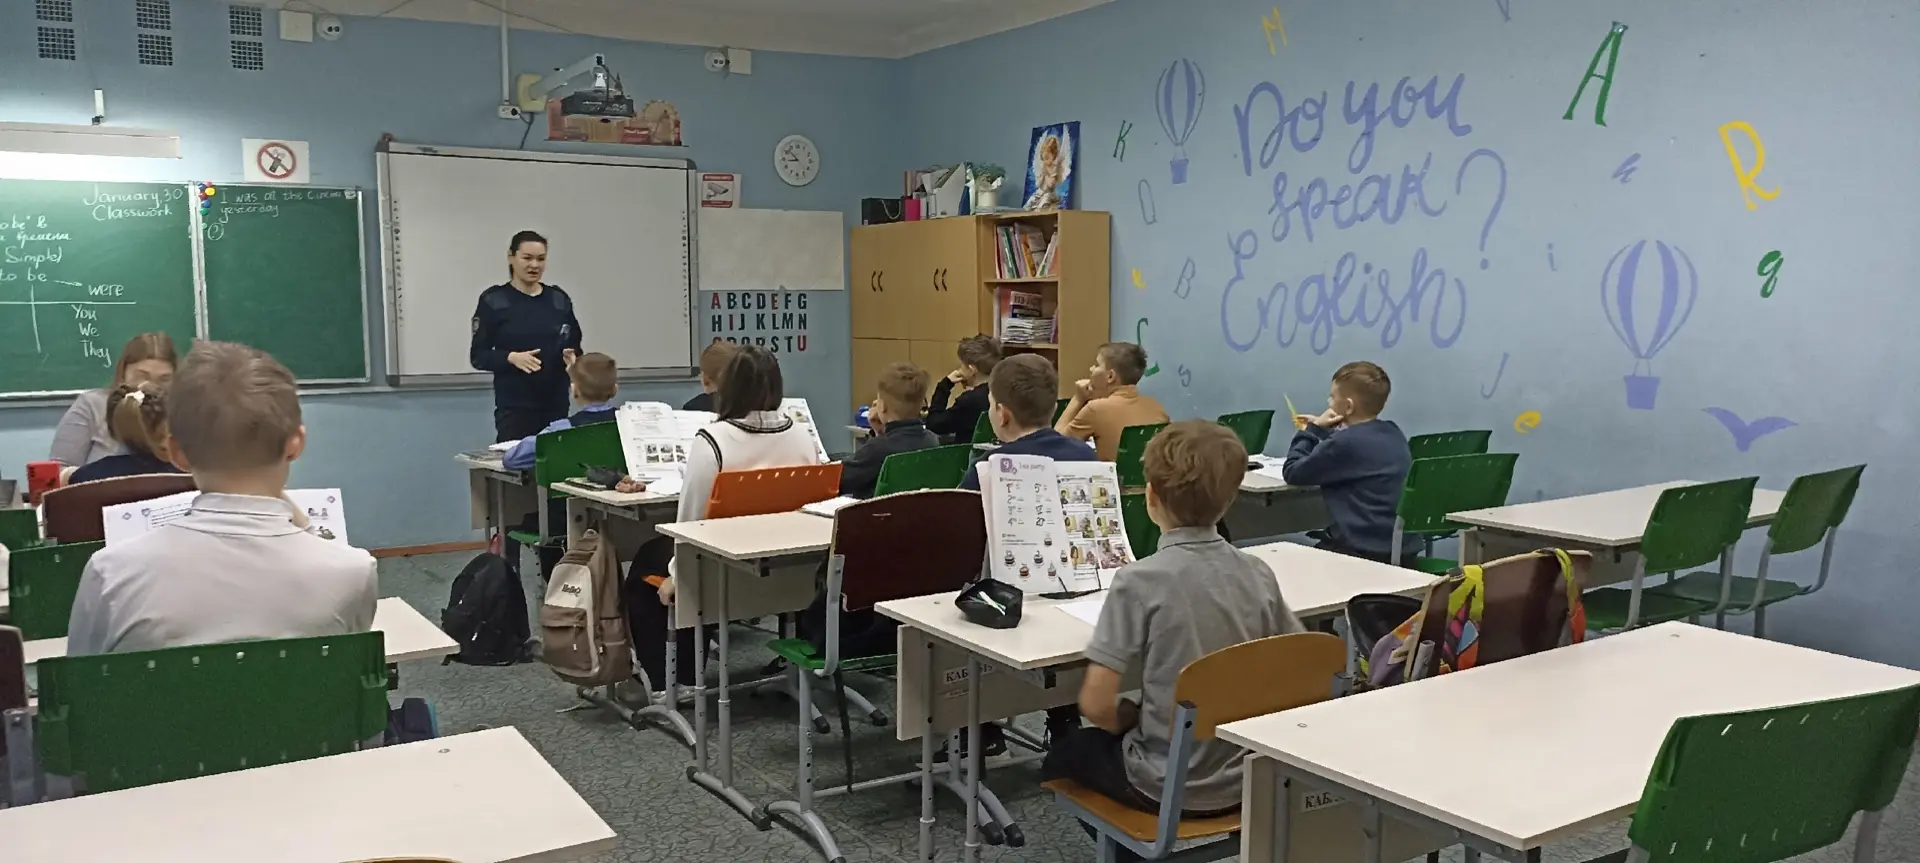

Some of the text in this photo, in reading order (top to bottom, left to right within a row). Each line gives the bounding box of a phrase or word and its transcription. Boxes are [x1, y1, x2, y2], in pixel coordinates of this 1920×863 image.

[1261, 6, 1289, 55] M
[1562, 21, 1628, 127] A
[1233, 72, 1472, 177] Do you
[1112, 119, 1133, 162] K
[1718, 120, 1781, 210] R
[92, 204, 173, 222] Classwork
[218, 204, 280, 224] yesterday
[27, 267, 48, 282] be
[88, 284, 124, 297] were
[1221, 228, 1467, 355] English
[71, 304, 98, 321] You
[78, 323, 100, 337] We
